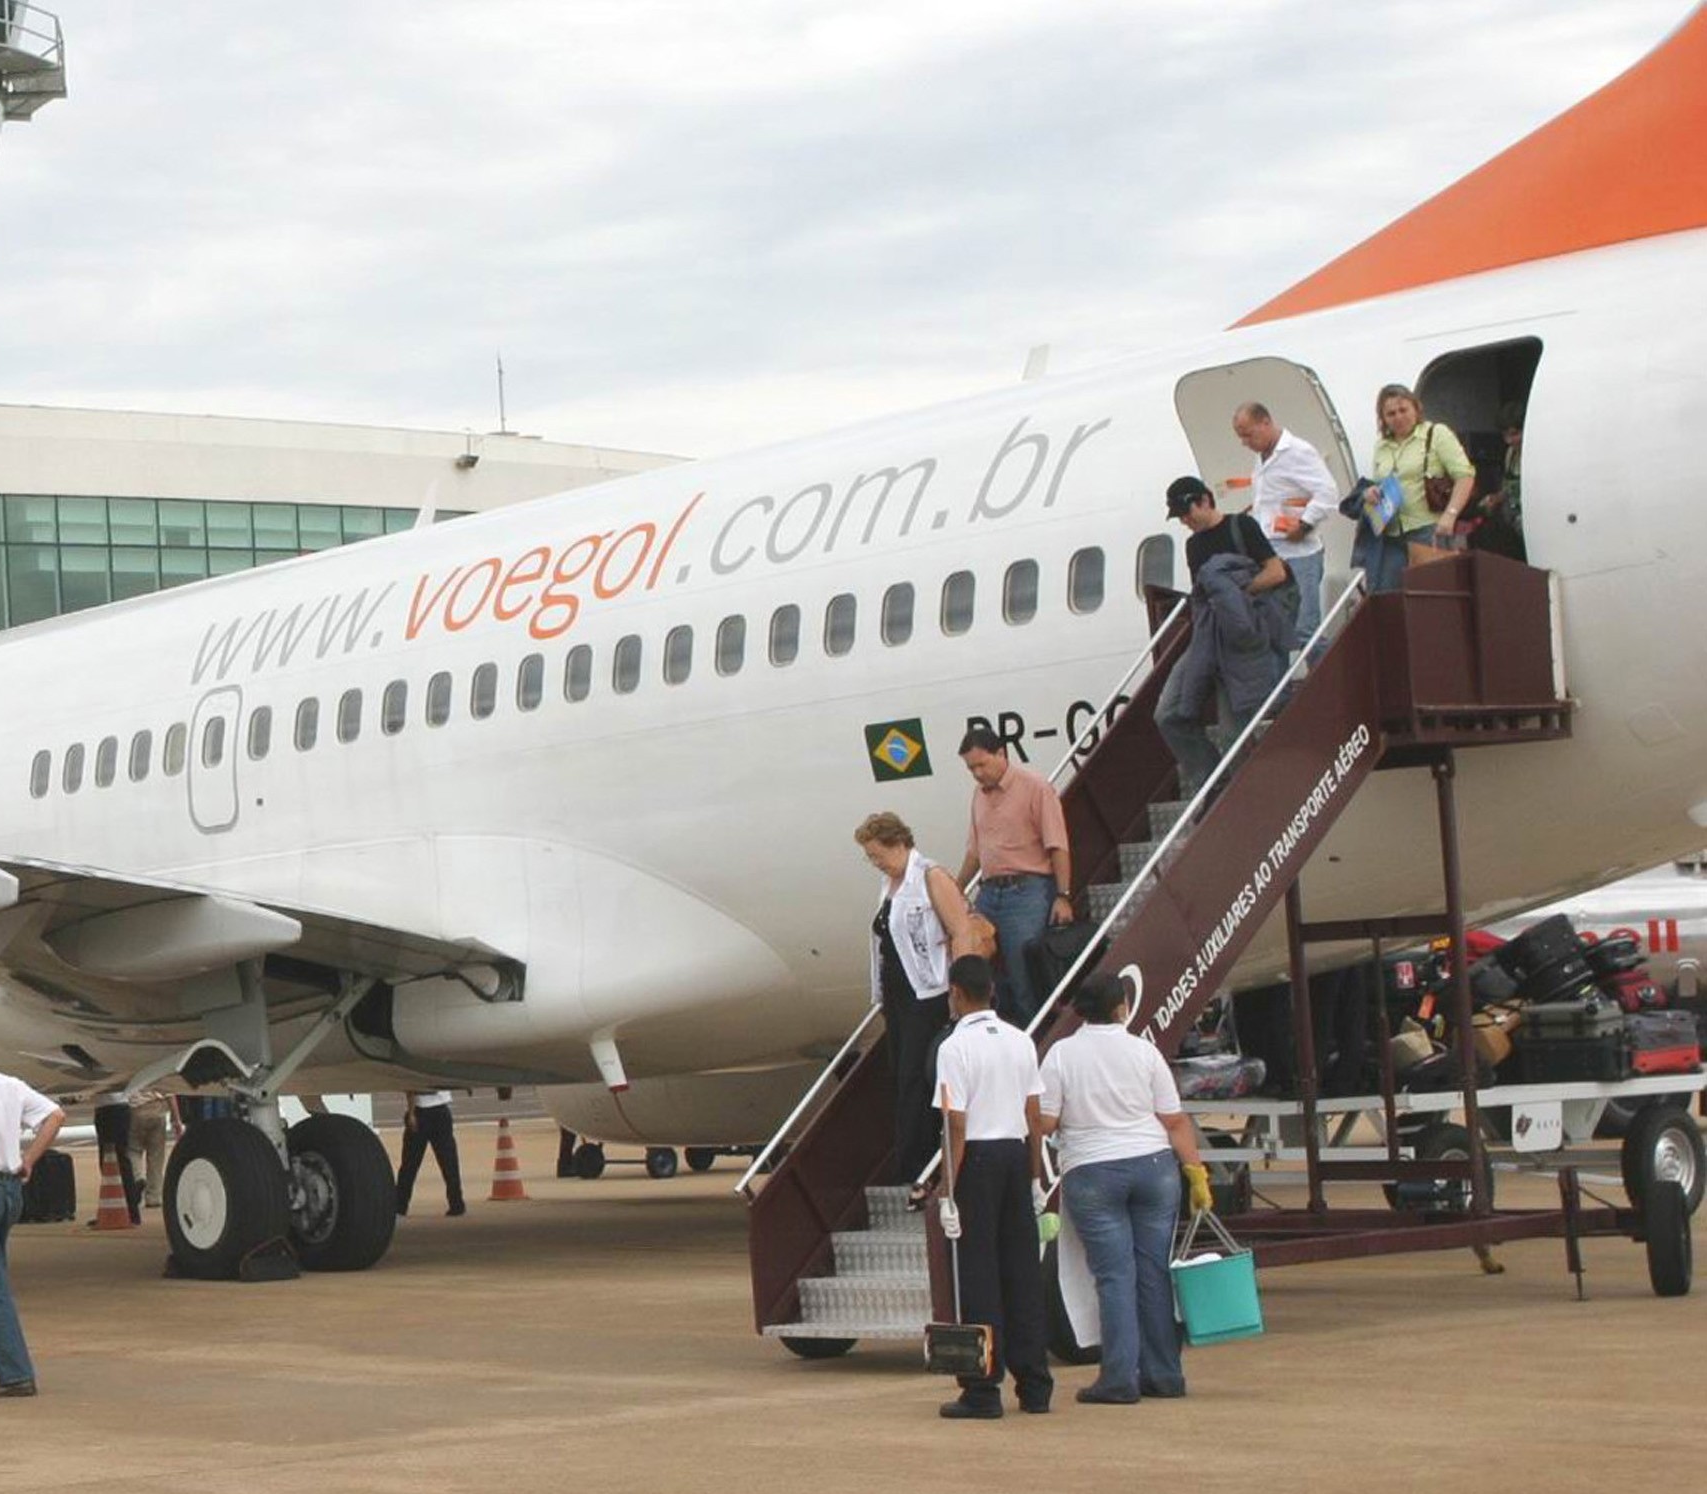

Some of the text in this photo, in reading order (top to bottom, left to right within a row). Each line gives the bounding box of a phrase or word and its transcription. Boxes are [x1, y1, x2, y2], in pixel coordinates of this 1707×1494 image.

[190, 416, 1112, 685] www.voegol.com.br
[1195, 884, 1256, 976] AUXILIARES
[1253, 861, 1273, 896] AO
[1268, 774, 1338, 871] TRANSPORTE
[1333, 723, 1371, 781] AÉREO
